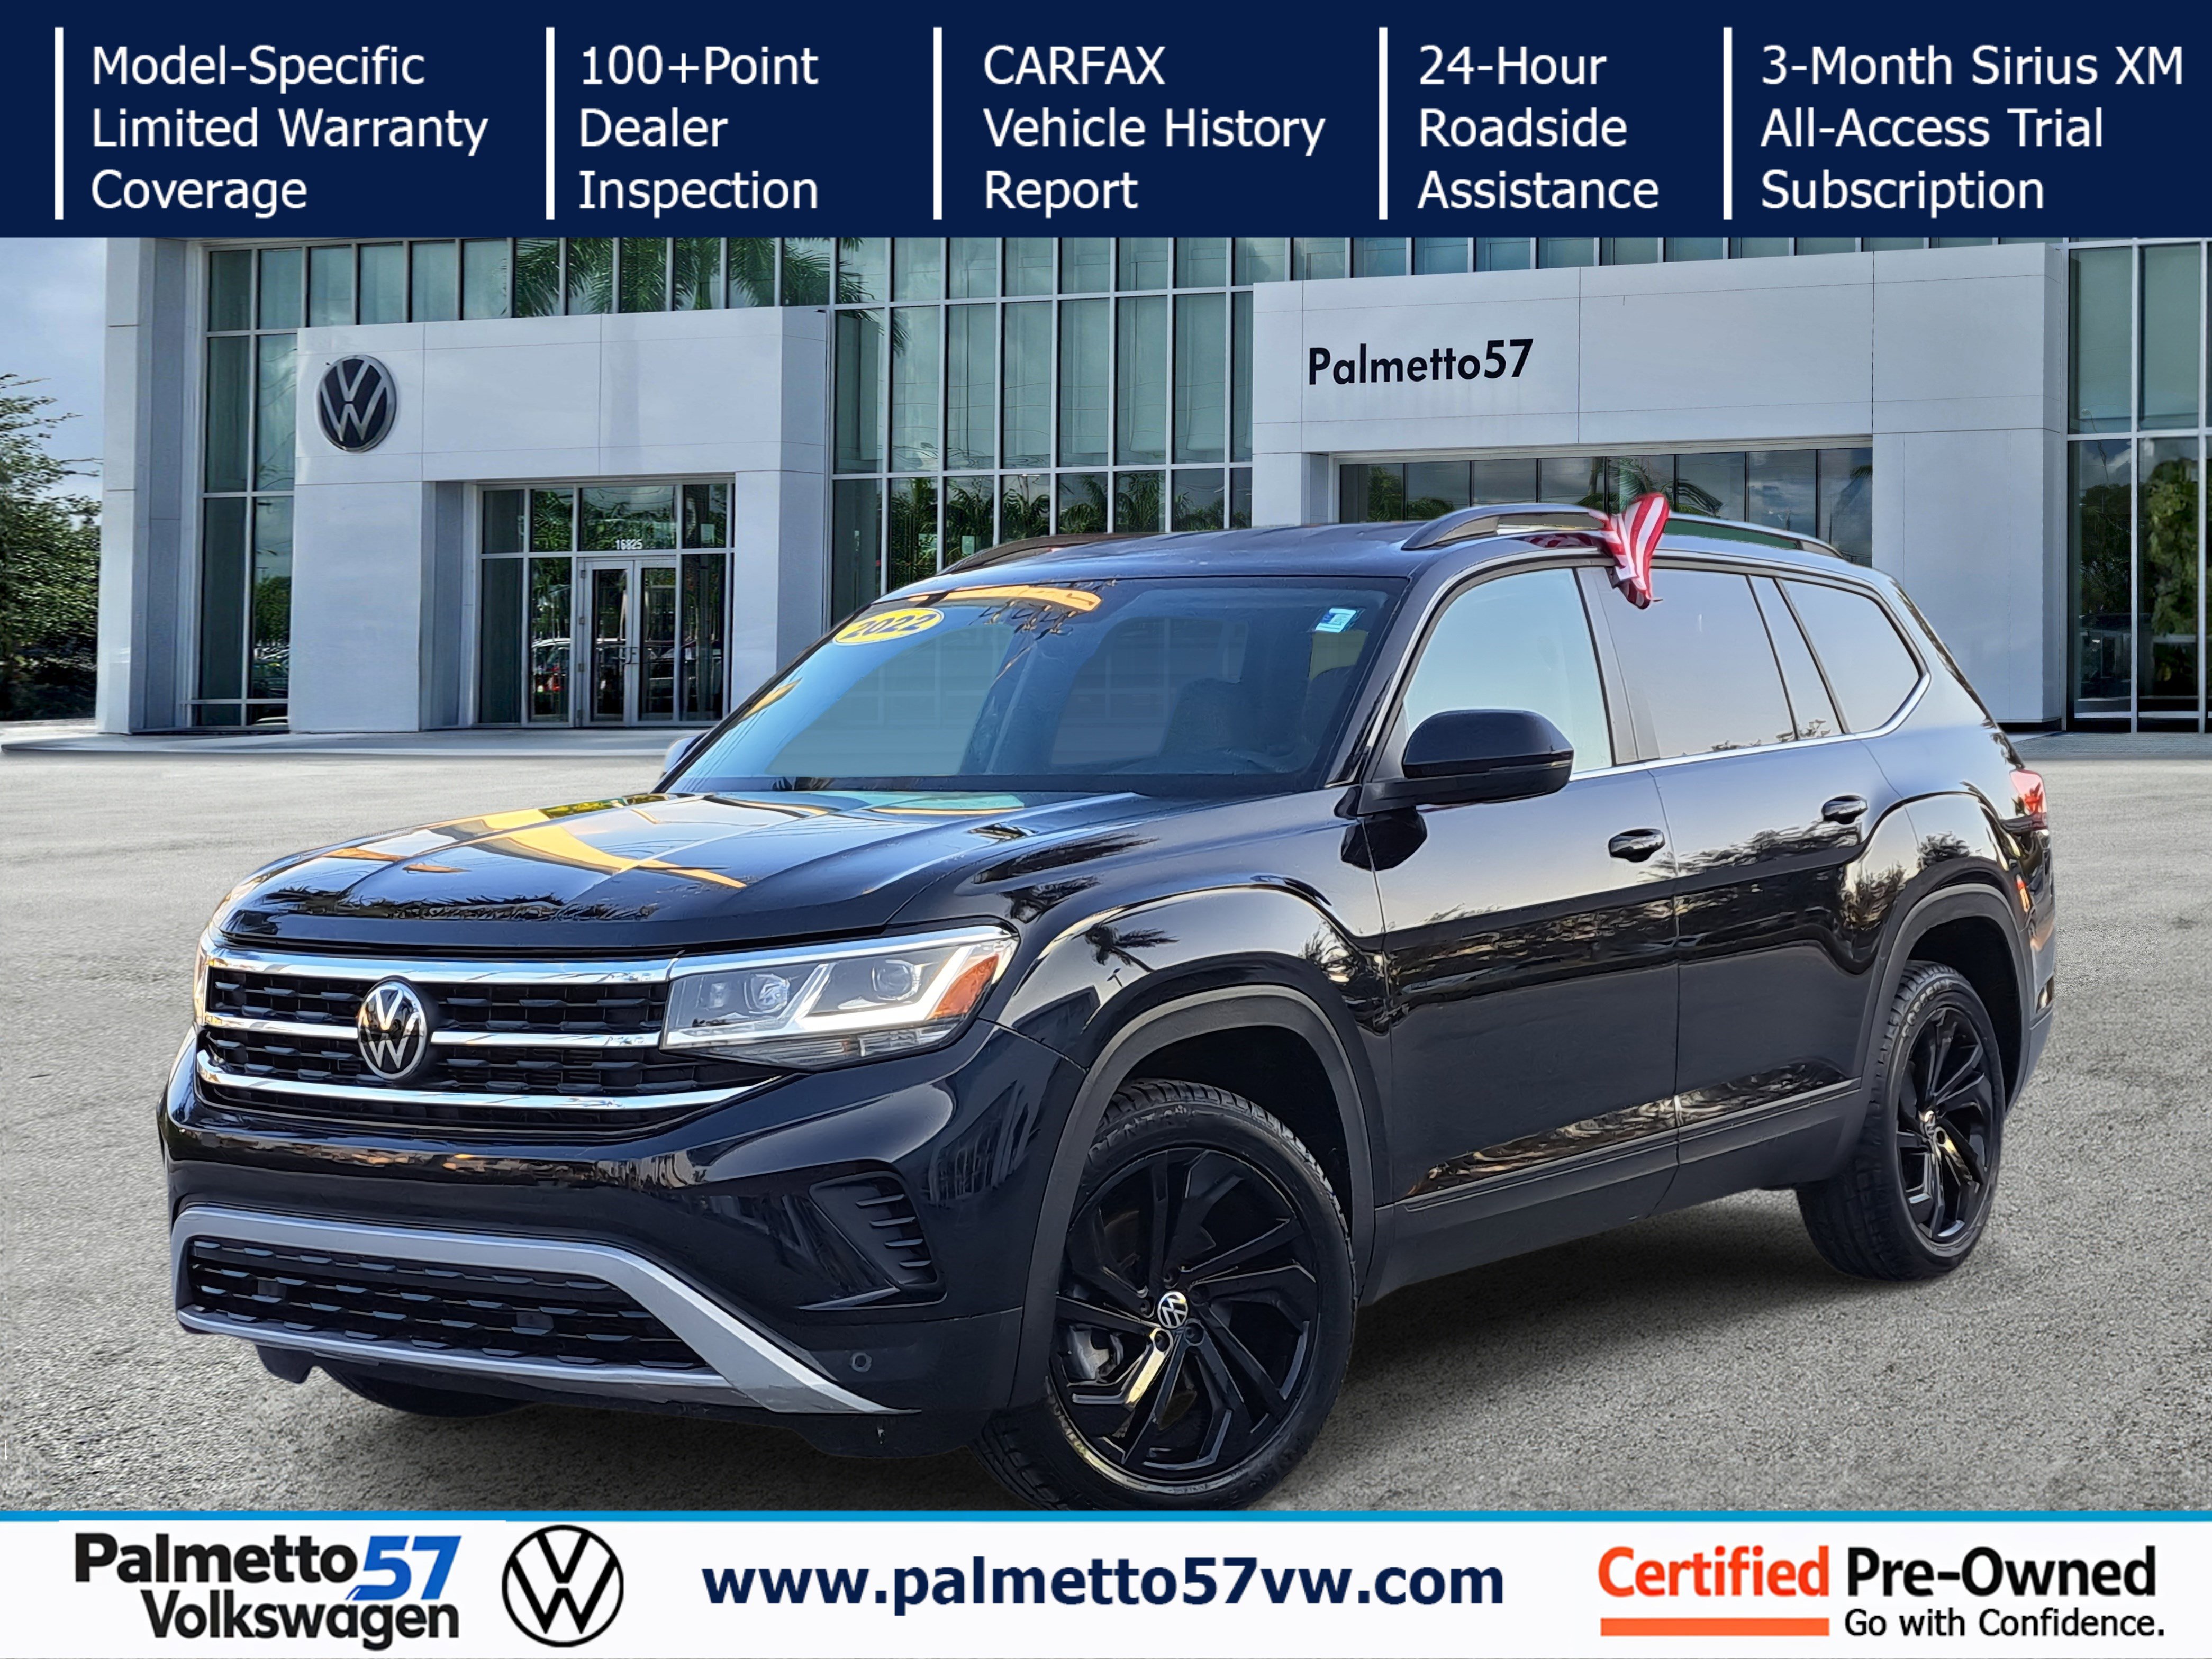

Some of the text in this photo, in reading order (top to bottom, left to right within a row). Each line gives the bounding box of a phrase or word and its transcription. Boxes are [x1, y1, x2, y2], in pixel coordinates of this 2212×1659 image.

[1309, 339, 1534, 385] Palmetto57
[615, 539, 643, 550] 16825
[839, 614, 938, 640] 2022
